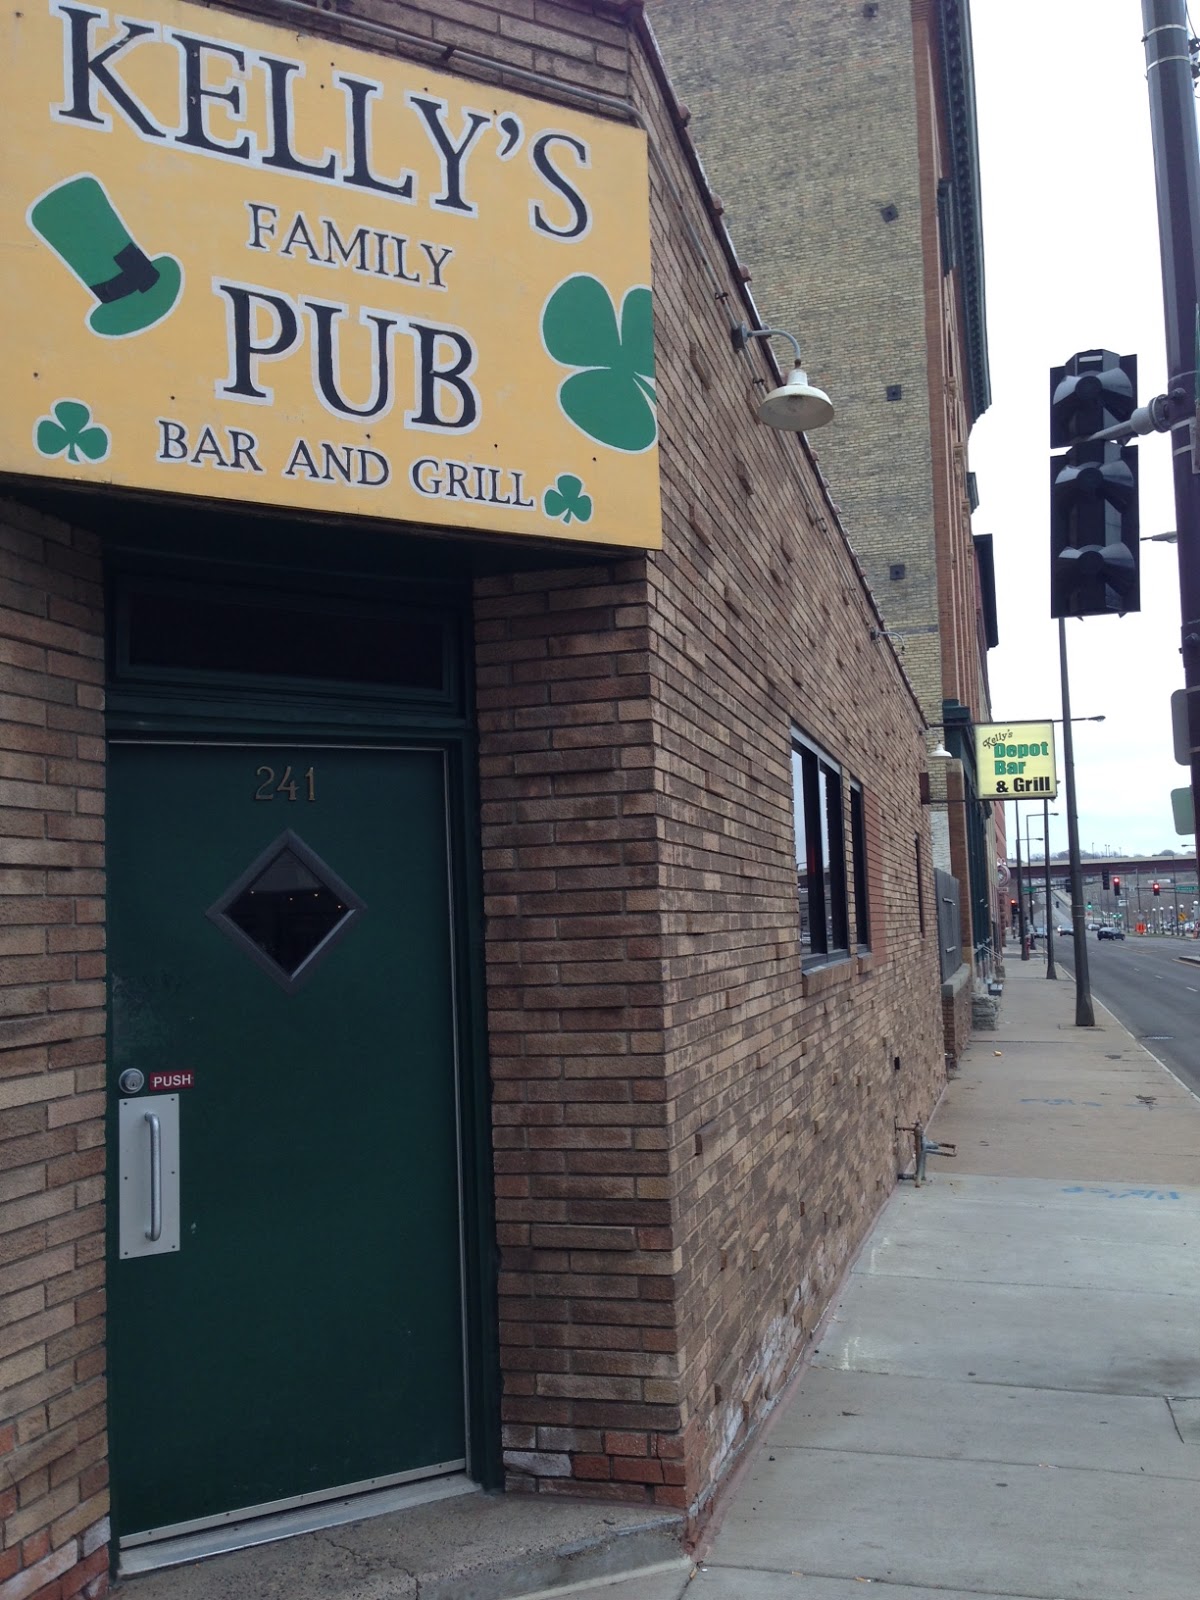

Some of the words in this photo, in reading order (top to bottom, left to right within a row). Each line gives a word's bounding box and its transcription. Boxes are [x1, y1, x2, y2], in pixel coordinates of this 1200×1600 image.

[58, 5, 589, 239] KELLY'S
[248, 203, 453, 288] FAMILY
[219, 284, 477, 429] PUB
[158, 420, 263, 472] BAR
[285, 440, 390, 487] AND
[411, 459, 535, 508] GRILL
[983, 729, 1013, 748] Kelly's
[994, 741, 1049, 758] Depot
[994, 760, 1026, 775] Bar
[255, 765, 316, 801] 241
[996, 780, 1009, 793] &
[1013, 776, 1051, 792] Grill
[153, 1074, 191, 1088] PUSH
